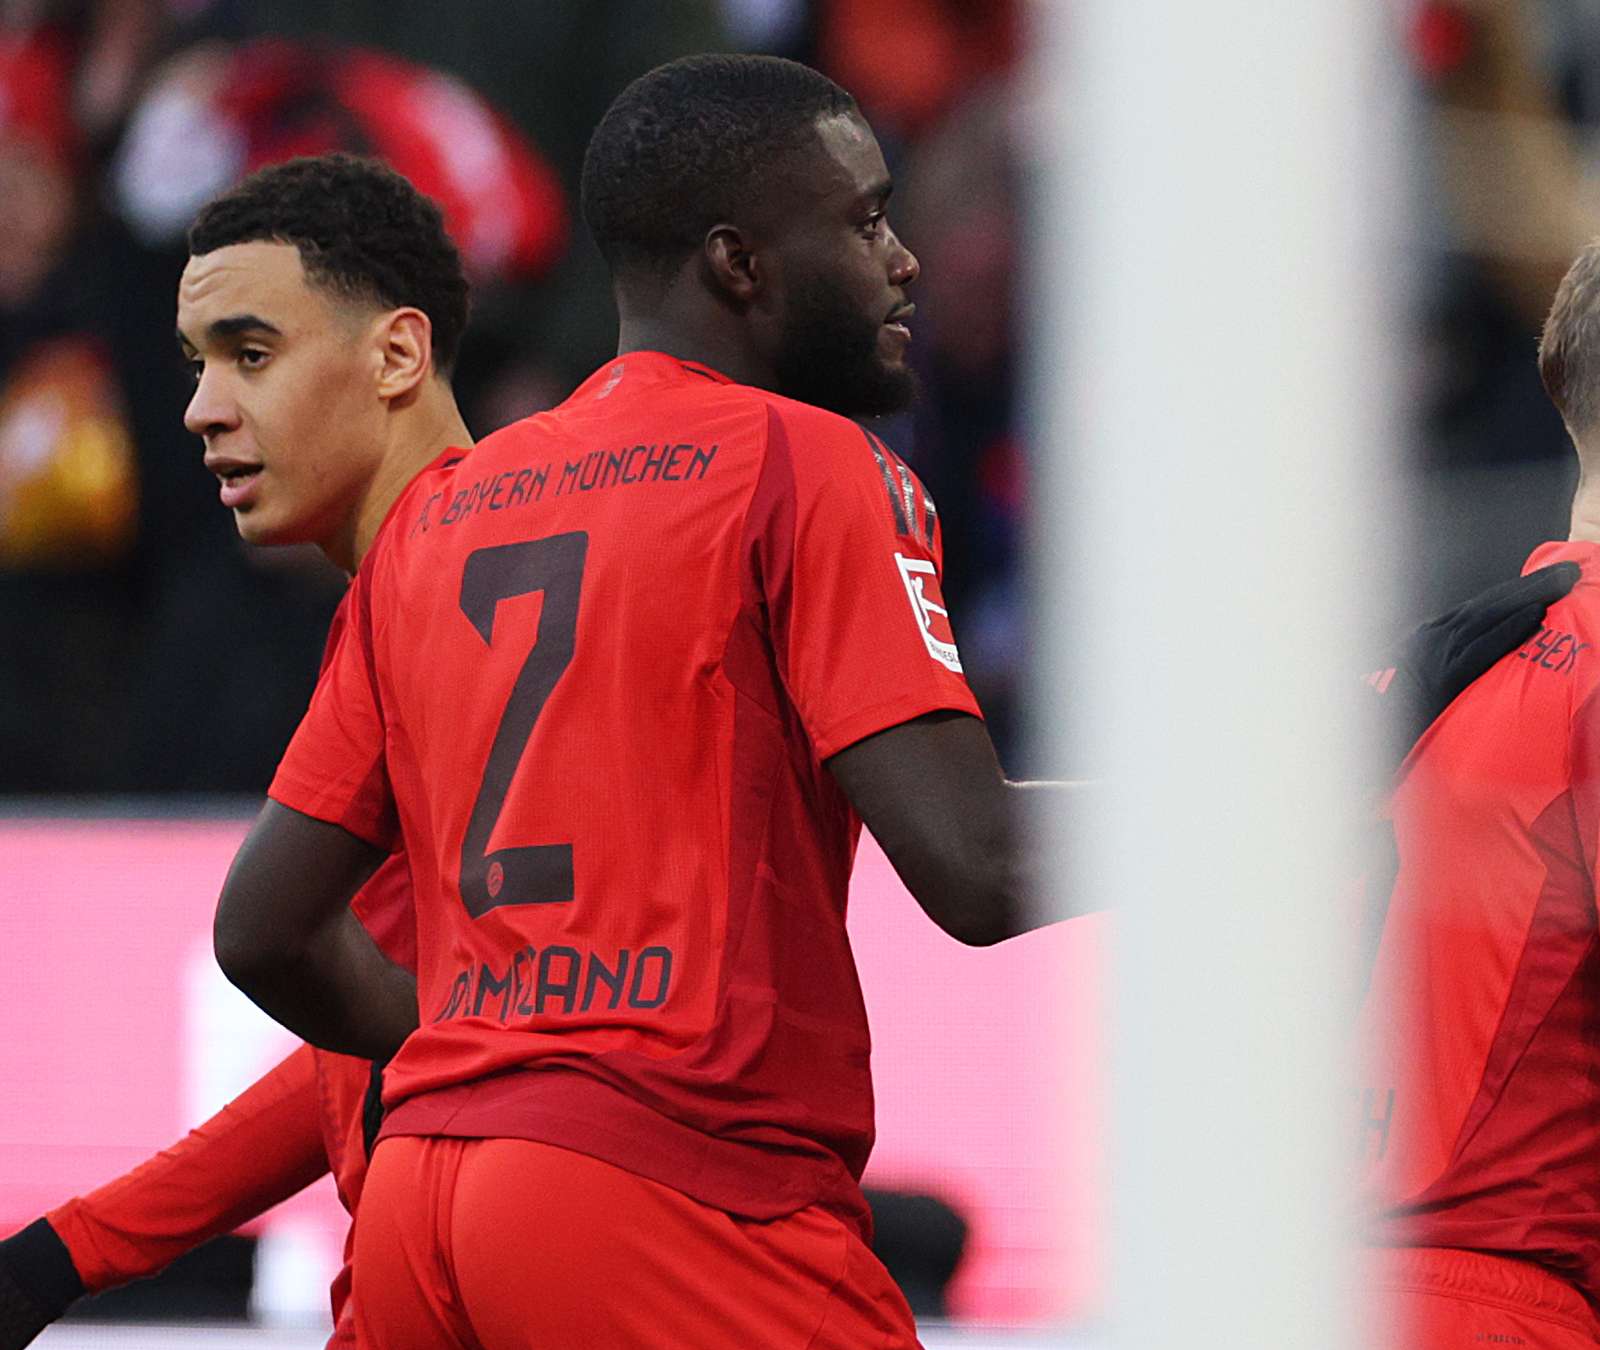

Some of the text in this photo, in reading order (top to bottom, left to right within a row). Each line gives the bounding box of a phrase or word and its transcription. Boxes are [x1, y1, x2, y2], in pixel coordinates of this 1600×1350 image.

[440, 464, 552, 525] BAYERN
[556, 444, 719, 497] MÜNCHEN
[459, 530, 589, 919] 2
